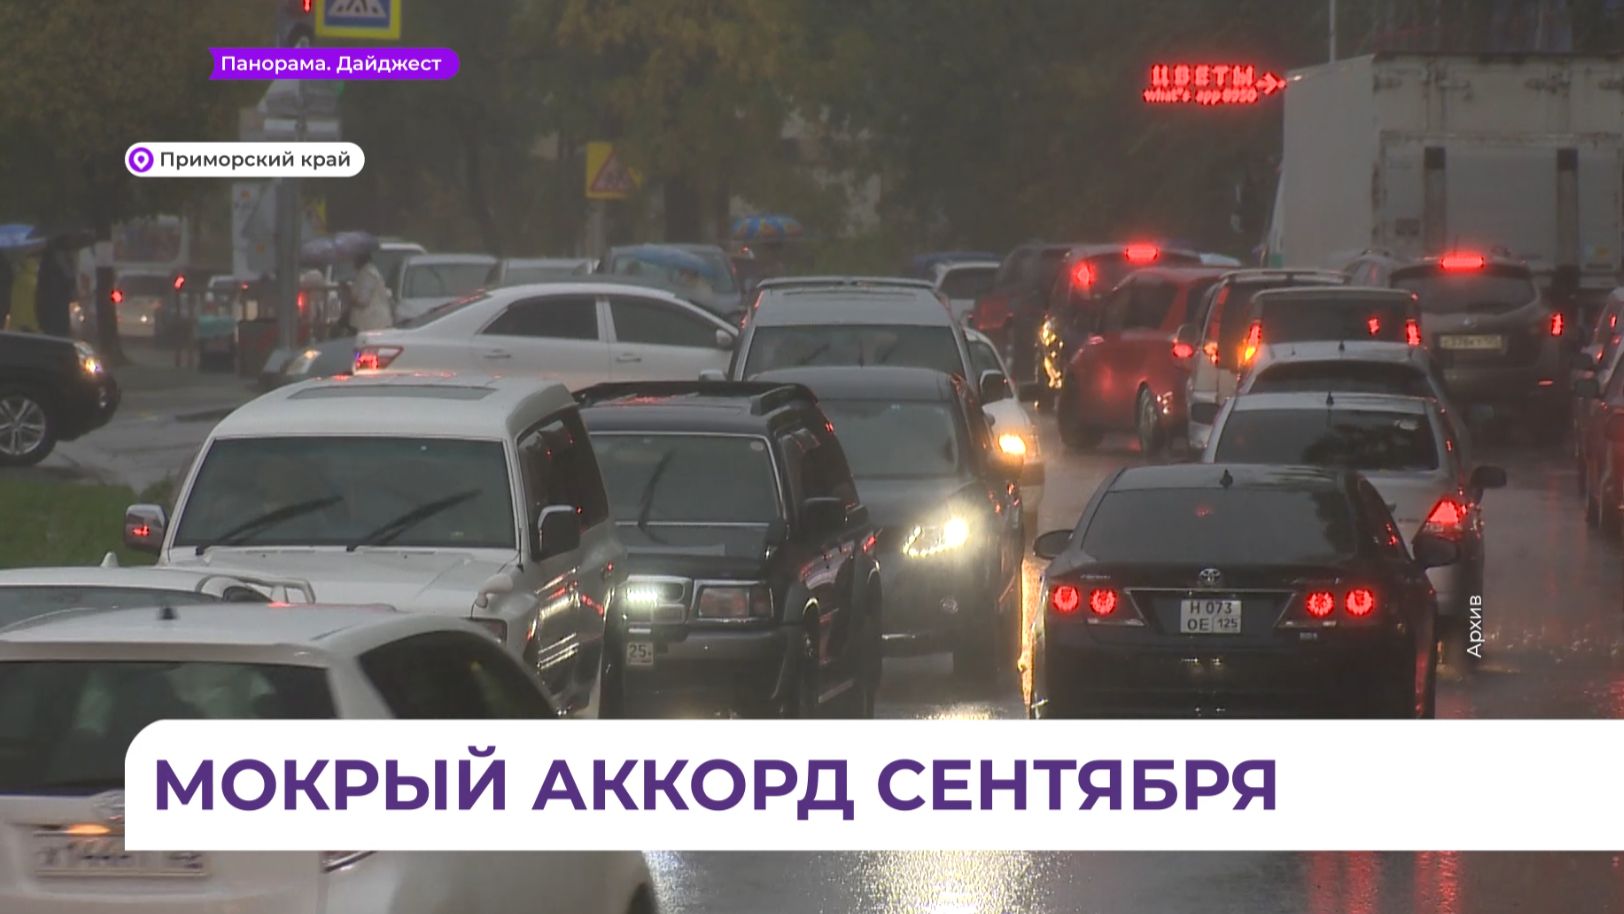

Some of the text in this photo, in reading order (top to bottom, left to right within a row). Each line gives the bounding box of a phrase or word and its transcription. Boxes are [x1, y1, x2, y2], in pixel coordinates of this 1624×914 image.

[1151, 64, 1254, 87] ЦВЕТЫ
[1205, 601, 1232, 615] 073
[1187, 618, 1238, 631] ОЕ 125
